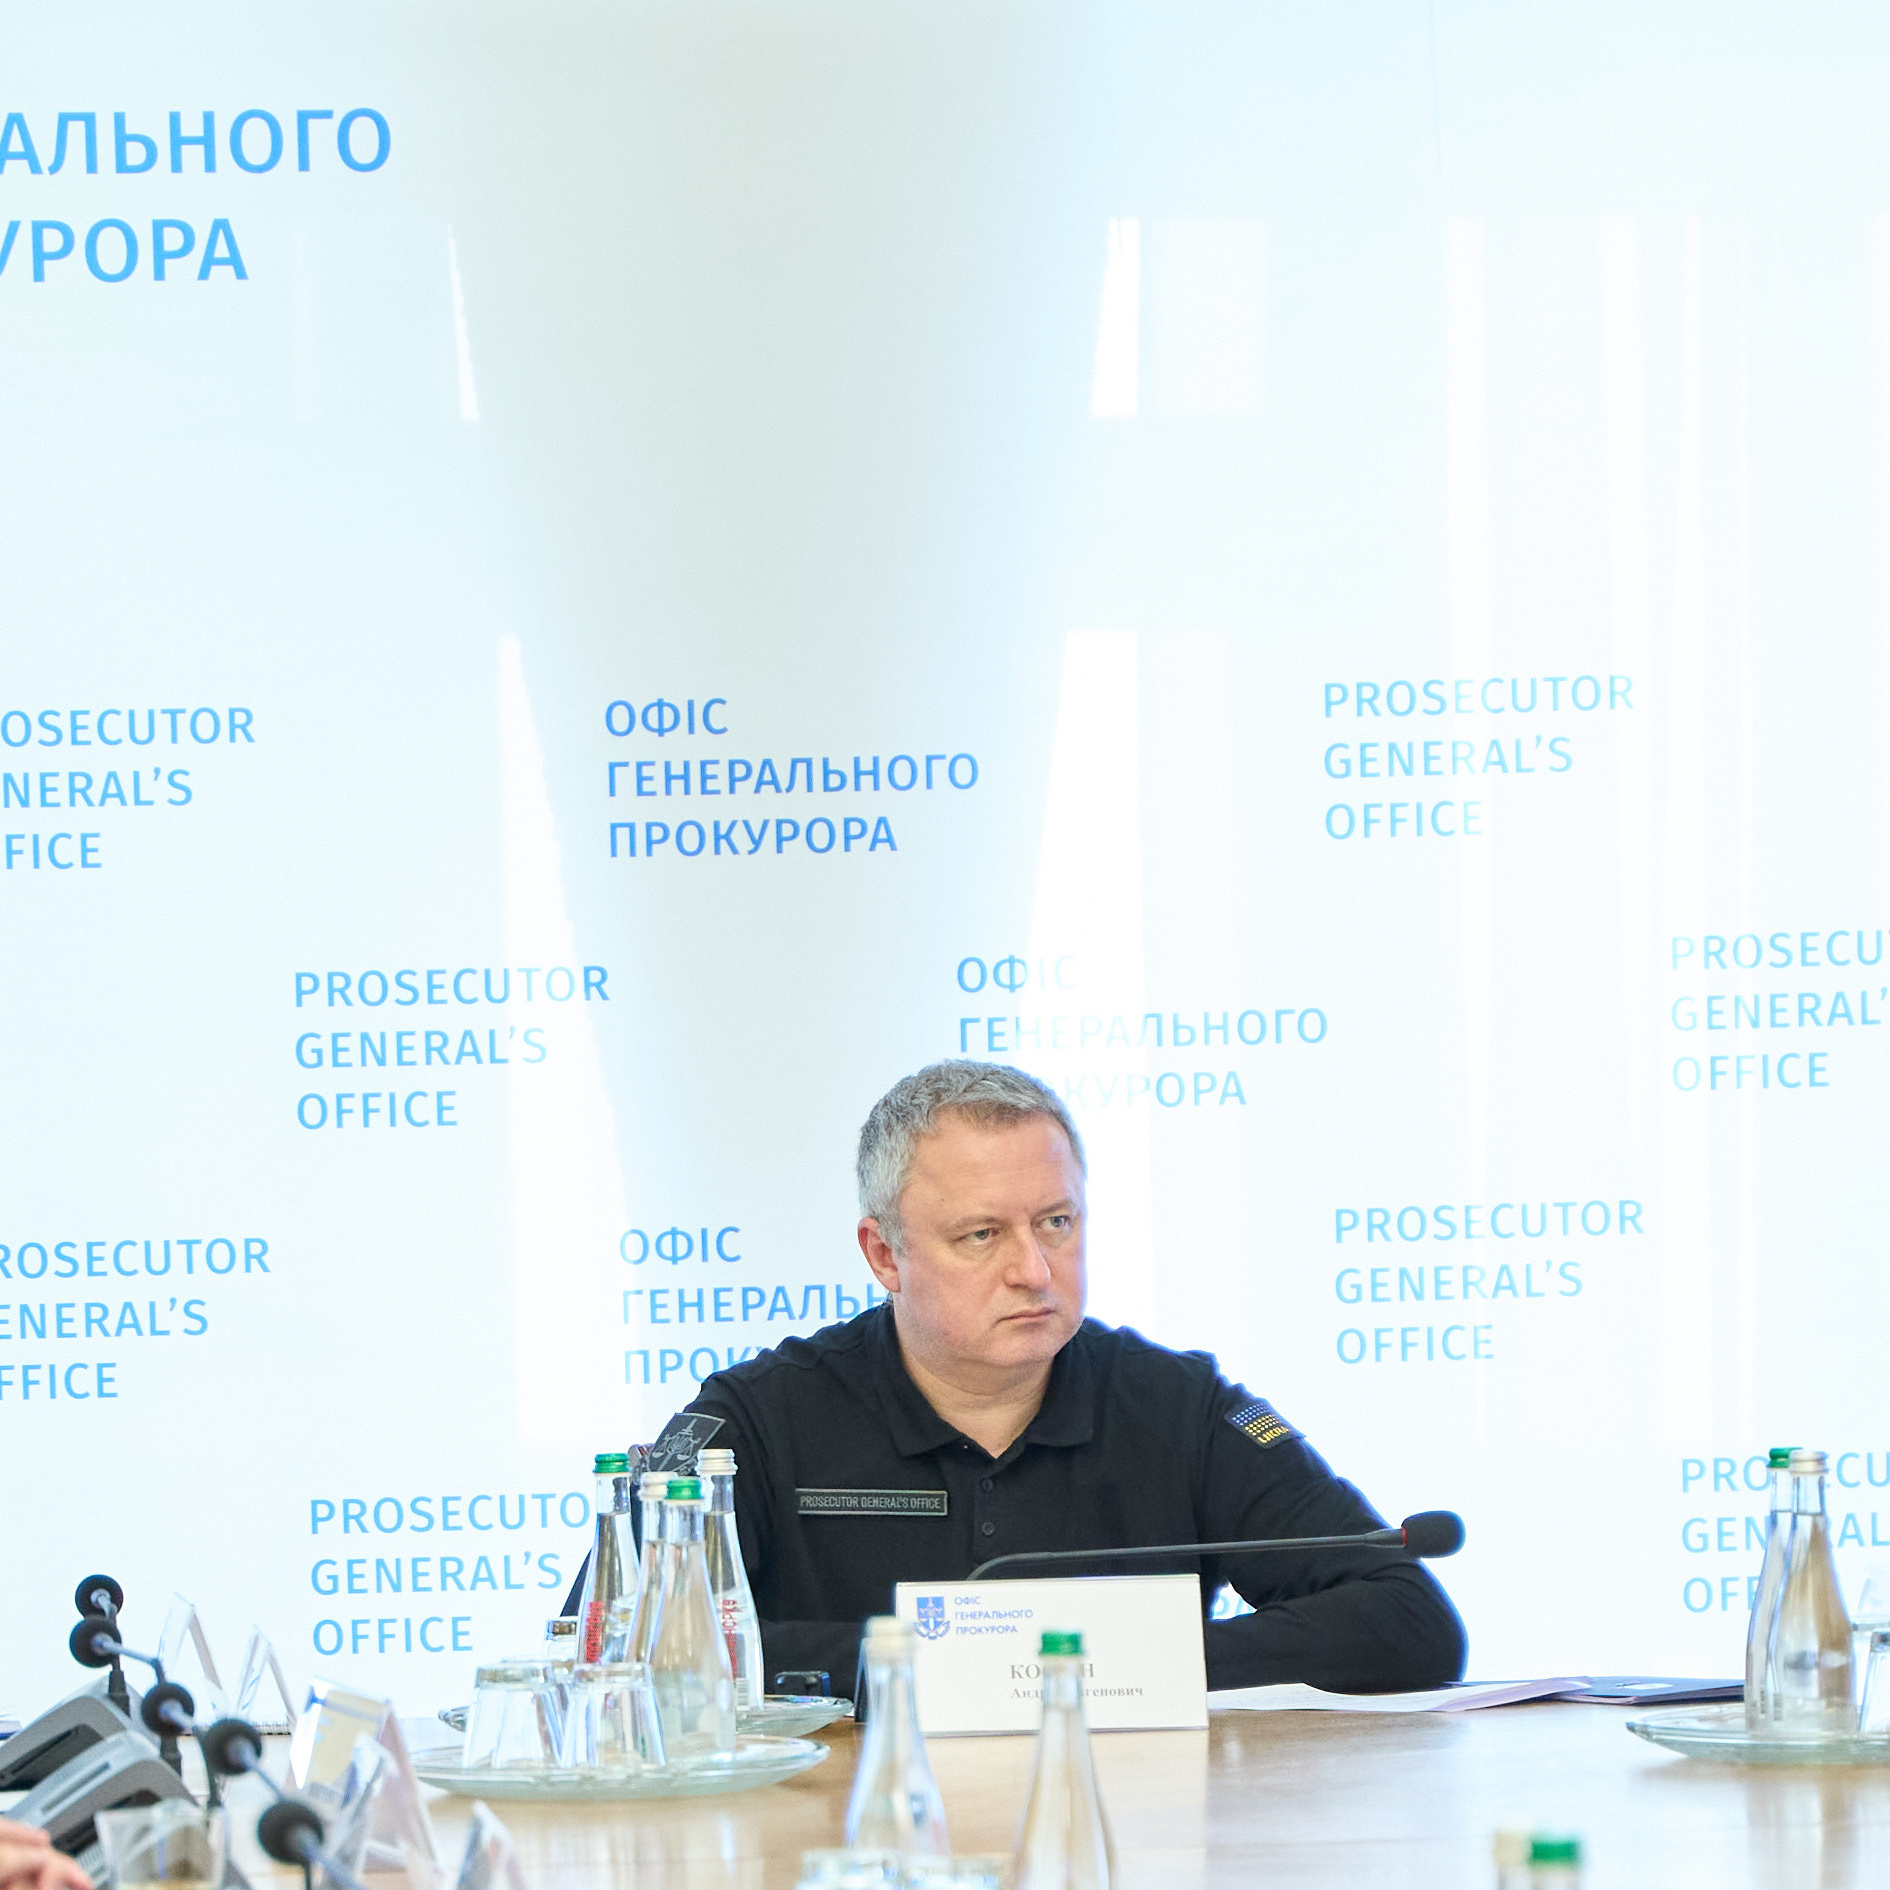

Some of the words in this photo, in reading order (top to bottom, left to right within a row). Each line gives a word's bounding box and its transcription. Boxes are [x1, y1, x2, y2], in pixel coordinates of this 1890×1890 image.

[603, 696, 729, 738] ОФІС
[1323, 674, 1633, 719] PROSECUTOR
[607, 752, 980, 798] ГЕНЕРАЛЬНОГО
[1323, 734, 1574, 781] GENERAL’S
[608, 815, 898, 859] ПРОКУРОРА
[1324, 799, 1481, 841] OFFICE
[294, 964, 610, 1008] PROSECUTOR
[294, 1026, 547, 1070] GENERAL’S
[958, 1006, 1329, 1054] ГЕНЕРАЛЬНОГО
[1053, 1070, 1247, 1110] КУРОРА
[1672, 1051, 1830, 1092] OFFICE
[296, 1090, 458, 1131] OFFICE
[1334, 1198, 1645, 1245] PROSECUTOR
[619, 1225, 742, 1266] ОФІС
[622, 1282, 888, 1323] ГЕНЕРАЛЬ
[1333, 1258, 1584, 1305] GENERAL’S
[1335, 1323, 1495, 1366] OFFICE
[309, 1491, 591, 1535] PROSECUTO
[801, 1495, 859, 1508] PROSECUTOR
[910, 1497, 940, 1509] OFFICE
[310, 1550, 563, 1596] GENERAL’S
[1682, 1575, 1759, 1614] OFF
[312, 1615, 473, 1657] OFFICE
